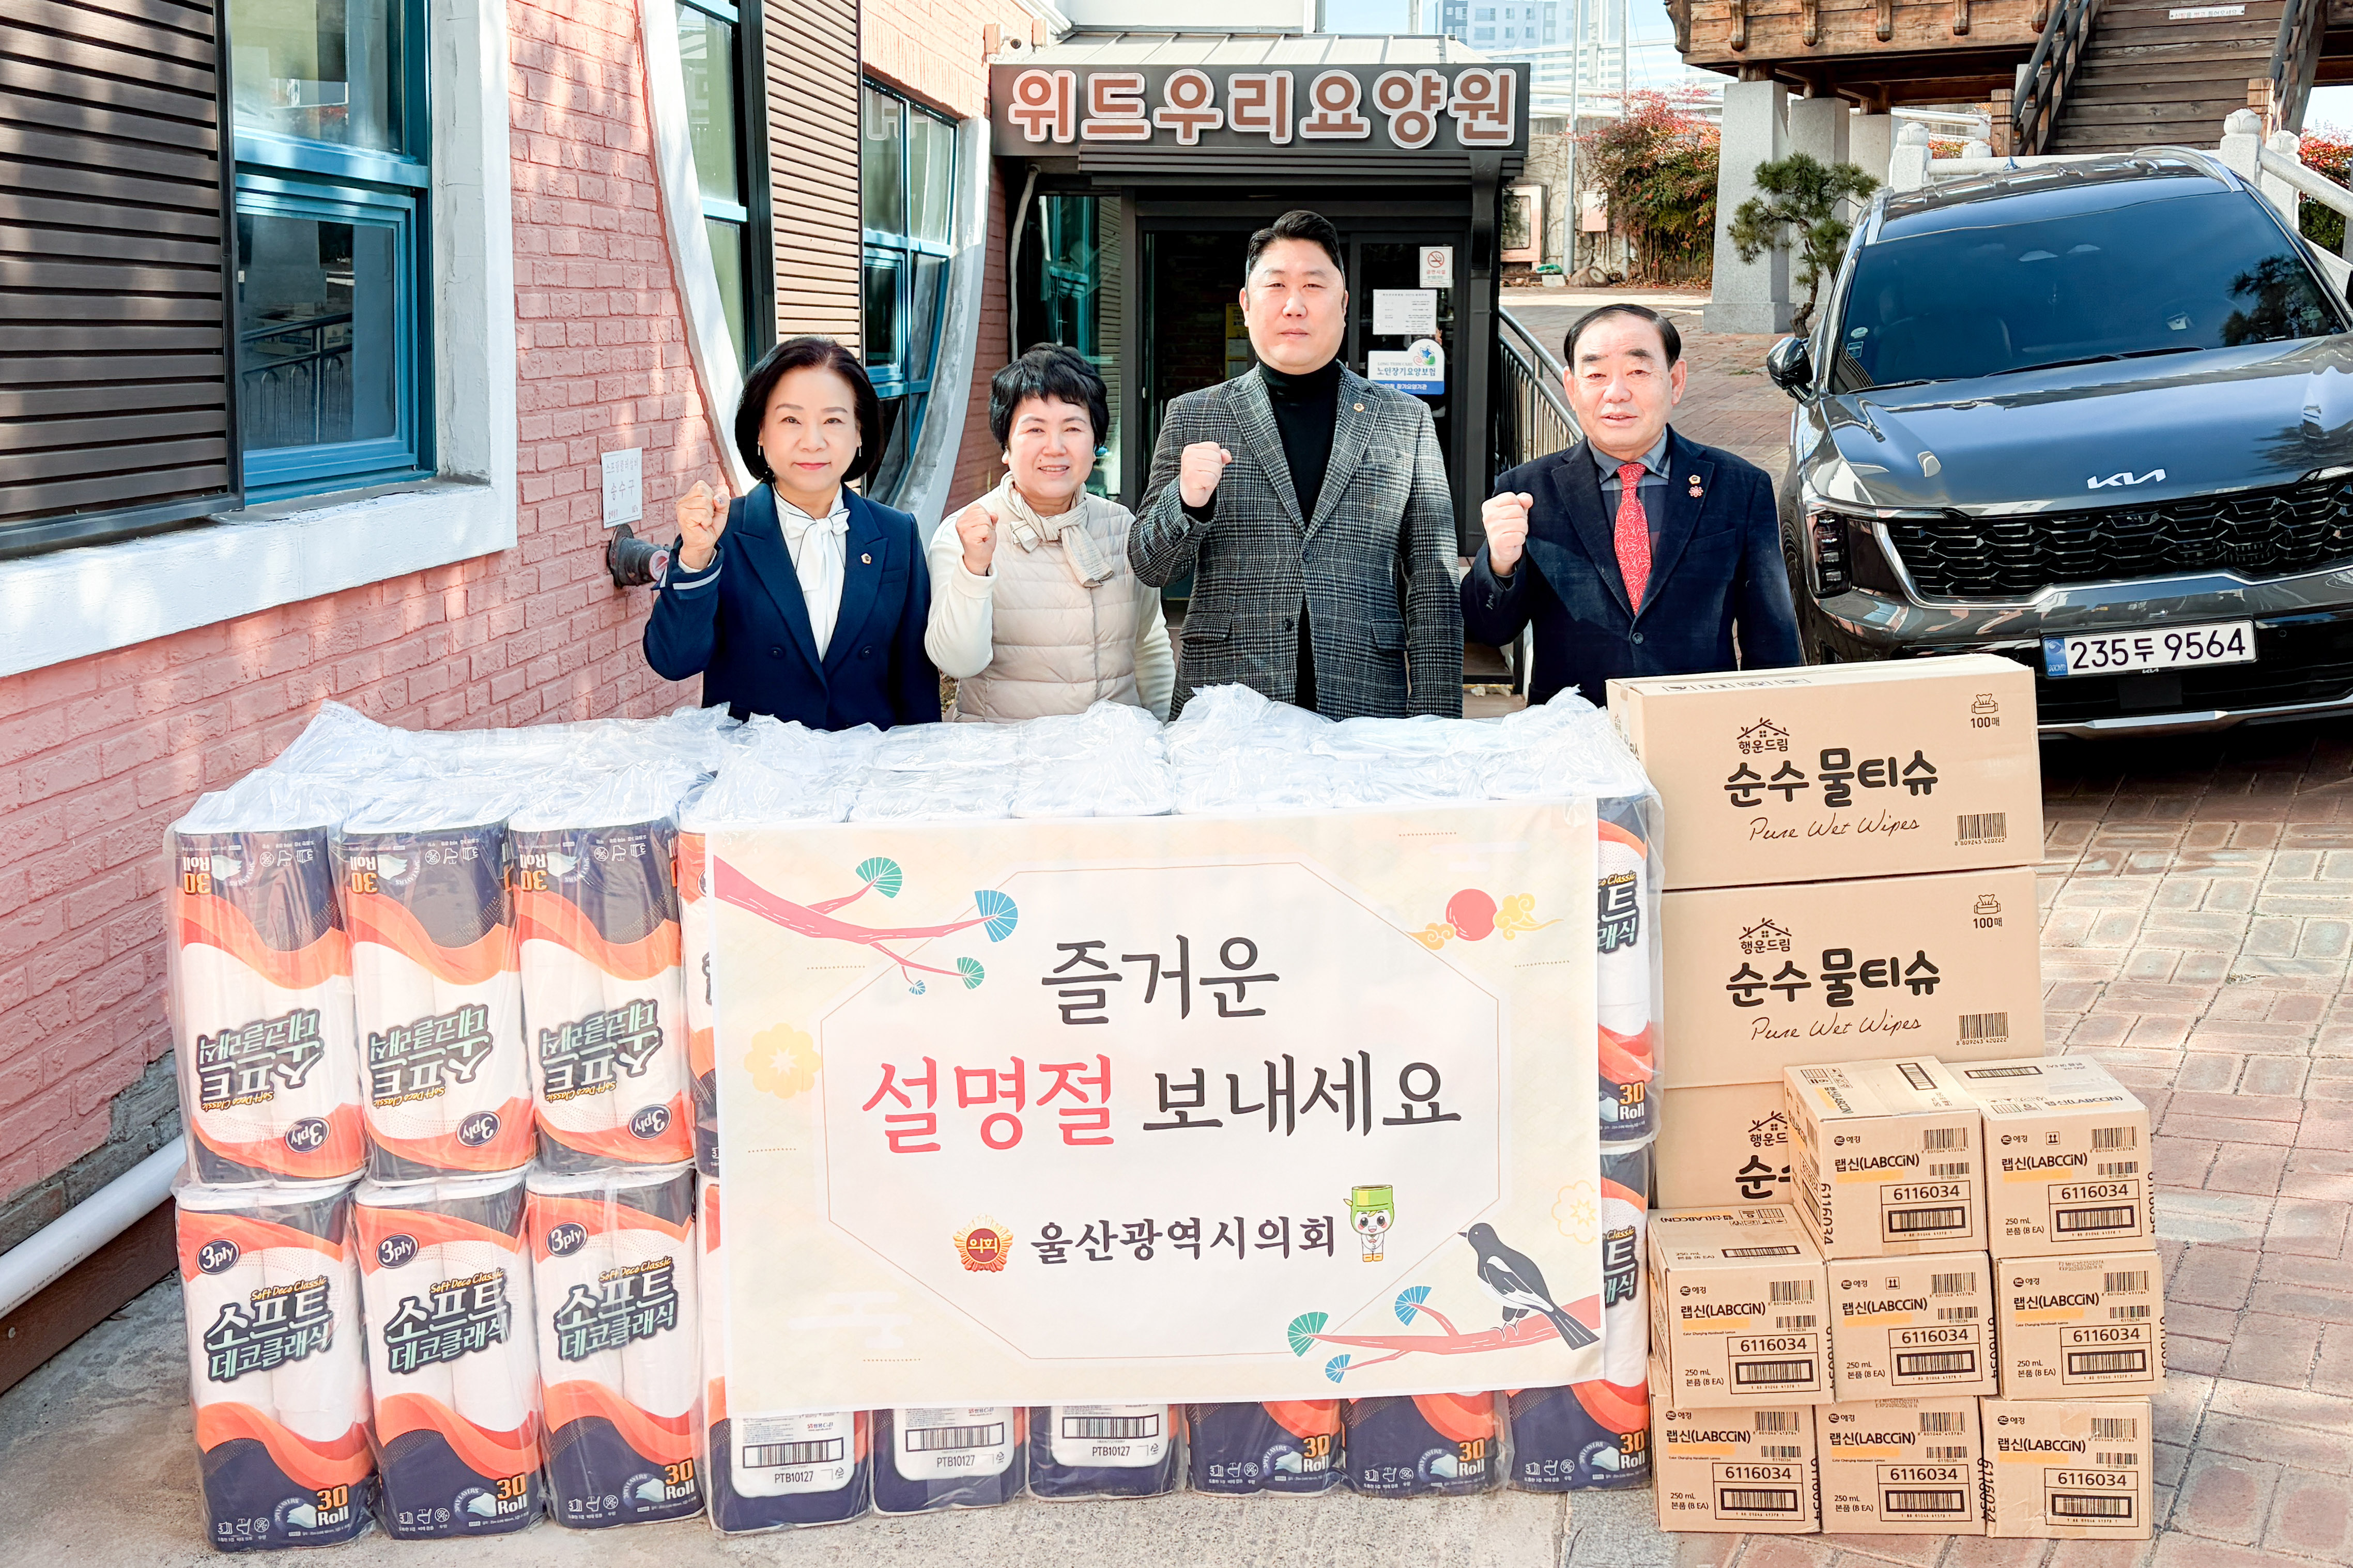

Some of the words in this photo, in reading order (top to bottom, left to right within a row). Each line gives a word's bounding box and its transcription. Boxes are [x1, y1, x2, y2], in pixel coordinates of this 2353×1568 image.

[1008, 68, 1516, 149] 위드우리요양원
[1377, 367, 1436, 376] 노인장기요양보험
[611, 479, 634, 500] 송수구
[2087, 469, 2166, 489] KIA
[2071, 638, 2155, 670] 235두
[2164, 627, 2246, 661] 9564
[1971, 717, 2000, 728] 100매
[1738, 738, 1788, 754] 행운드림
[1724, 760, 1809, 807] 순수
[1818, 748, 1938, 808] 물티슈
[1750, 817, 1798, 841] Pure
[1808, 813, 1850, 836] Wet
[1858, 809, 1920, 836] Wipes
[183, 857, 210, 872] Roll
[350, 856, 377, 871] Roll
[520, 854, 548, 868] Roll
[184, 873, 211, 895] 30
[351, 872, 378, 893] 30
[520, 870, 548, 891] 30
[1973, 917, 2002, 928] 100매
[1740, 938, 1791, 955] 행운드림
[1041, 934, 1280, 1025] 즐거운
[1726, 960, 1811, 1007] 순수
[1820, 948, 1941, 1007] 물티슈
[371, 1008, 485, 1062] 데코클래식
[543, 1003, 654, 1057] 데코클래식
[1751, 1017, 1800, 1041] Pure
[1809, 1012, 1852, 1036] Wet
[1859, 1008, 1921, 1036] Wipes
[199, 1013, 316, 1064] 데코클래식
[199, 1041, 321, 1101] 소프트
[371, 1035, 489, 1098] 소프트
[543, 1030, 659, 1093] 소프트
[255, 1091, 274, 1101] Soft
[404, 1092, 424, 1101] Deco
[427, 1086, 445, 1096] Soft
[546, 1091, 575, 1102] Classic
[576, 1086, 595, 1096] Deco
[597, 1081, 617, 1092] Soft
[1620, 1081, 1644, 1105] 30
[202, 1100, 232, 1111] Classic
[232, 1095, 253, 1106] Deco
[373, 1096, 403, 1107] Classic
[862, 1053, 1115, 1154] 설명절
[1143, 1049, 1462, 1137] 보내세요
[1620, 1102, 1644, 1120] Roll
[463, 1116, 494, 1140] 3ply
[634, 1110, 665, 1132] 3ply
[291, 1123, 323, 1146] 3ply
[1750, 1132, 1788, 1147] 행운드
[1894, 1185, 1960, 1200] 6116034
[2062, 1184, 2129, 1200] 6116034
[1821, 1183, 1834, 1245] 6116034
[550, 1229, 582, 1252] 3ply
[967, 1237, 998, 1253] 의회
[1031, 1216, 1334, 1265] 울산광역시의회
[202, 1246, 234, 1269] 3ply
[381, 1240, 412, 1263] 3ply
[599, 1271, 619, 1282] Soft
[620, 1267, 640, 1277] Deco
[640, 1255, 672, 1272] Classic
[251, 1290, 272, 1301] Soft
[272, 1286, 293, 1296] Deco
[294, 1276, 327, 1292] Classic
[557, 1266, 674, 1330] 소프트
[207, 1286, 329, 1351] 소프트
[387, 1278, 507, 1343] 소프트
[561, 1300, 674, 1358] 데코클래식
[1902, 1329, 1968, 1343] 6116034
[2073, 1328, 2141, 1342] 6116034
[211, 1323, 329, 1378] 데코클래식
[1741, 1338, 1807, 1352] 6116034
[1092, 1446, 1130, 1456] PTB10127
[1303, 1435, 1330, 1457] 30
[1459, 1438, 1485, 1462] 30
[1620, 1431, 1644, 1454] 30
[937, 1455, 975, 1467] PTB10127
[1303, 1454, 1330, 1472] Roll
[1459, 1459, 1485, 1476] Roll
[1620, 1450, 1645, 1469] Roll
[665, 1459, 694, 1485] 30
[775, 1471, 814, 1483] PTB10127
[1726, 1467, 1792, 1479] 6116034
[1890, 1468, 1958, 1481] 6116034
[2058, 1472, 2127, 1486] 6116034
[496, 1474, 526, 1499] 30
[665, 1479, 695, 1500] Roll
[316, 1485, 348, 1511] 30
[498, 1494, 528, 1515] Roll
[318, 1505, 349, 1526] Roll
